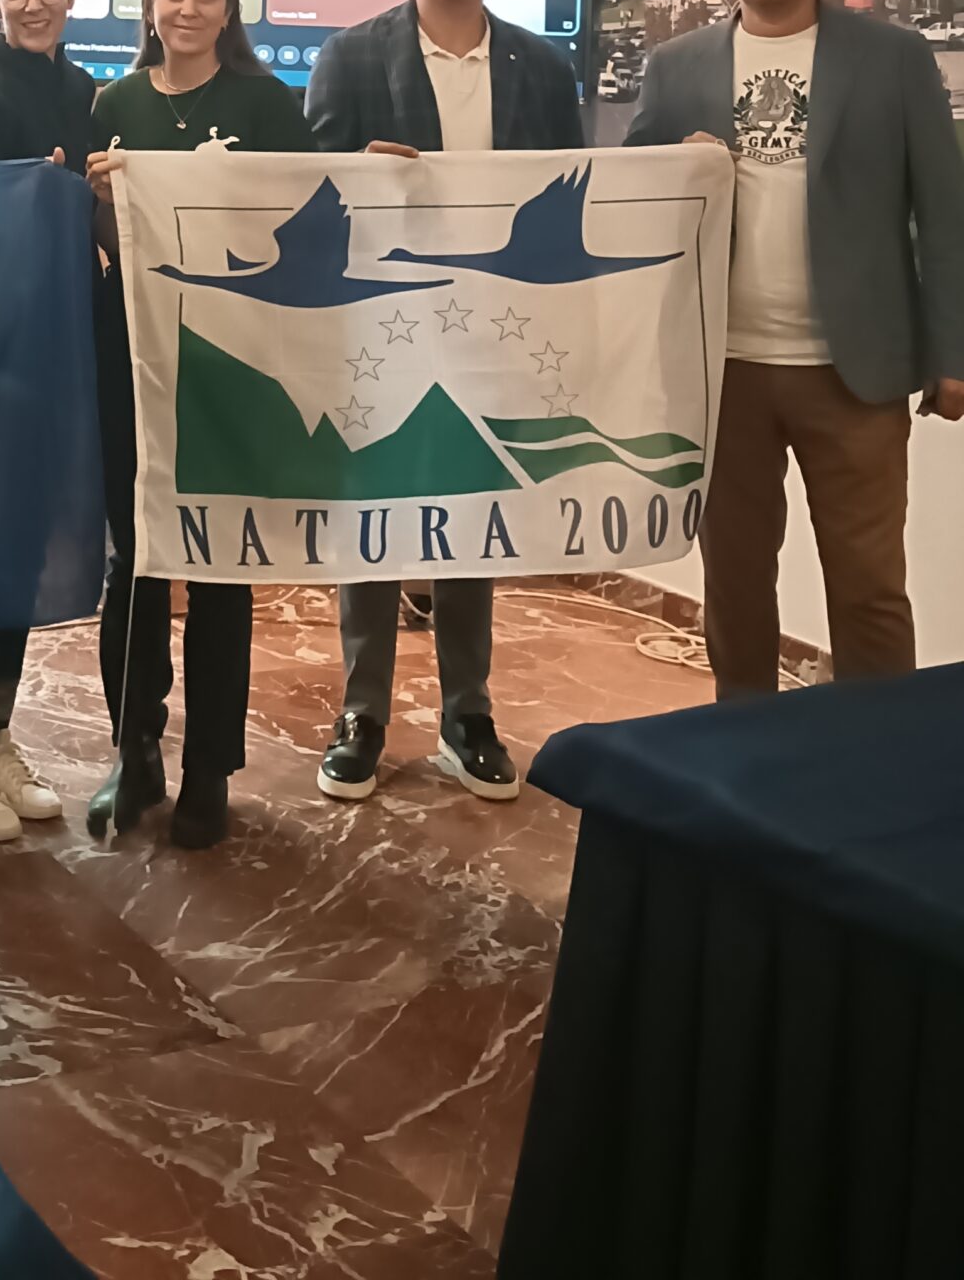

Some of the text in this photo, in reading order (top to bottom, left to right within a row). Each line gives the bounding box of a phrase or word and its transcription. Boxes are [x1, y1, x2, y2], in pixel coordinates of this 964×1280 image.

[742, 69, 807, 90] NAUTICA
[176, 488, 702, 566] NATURA 2000
